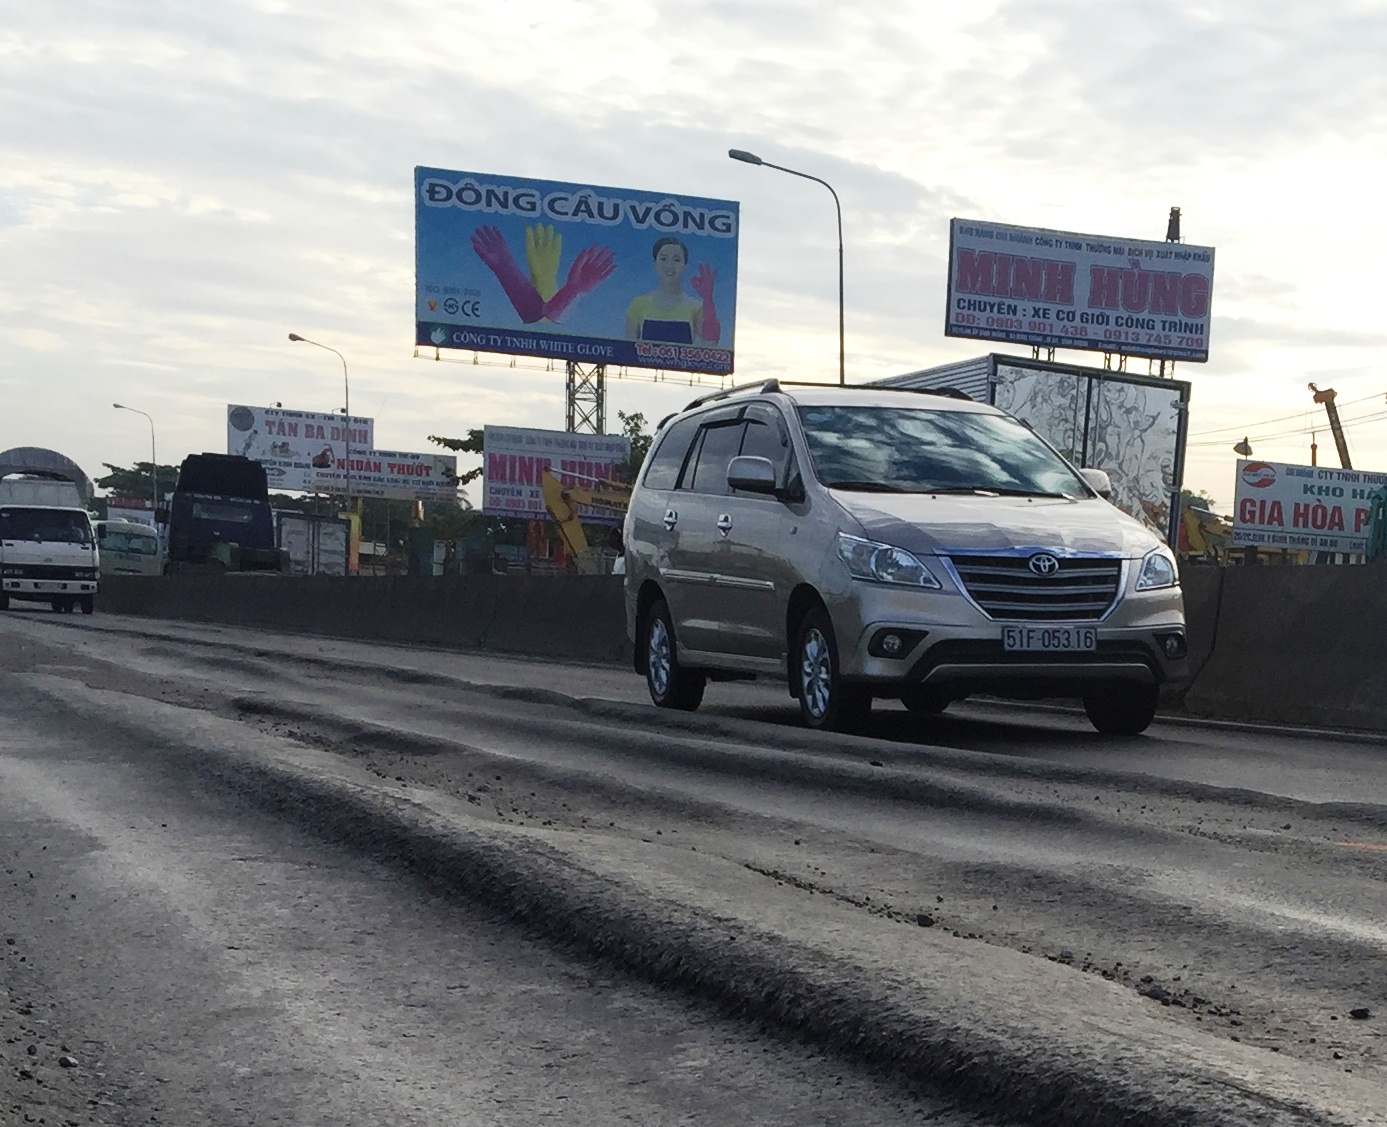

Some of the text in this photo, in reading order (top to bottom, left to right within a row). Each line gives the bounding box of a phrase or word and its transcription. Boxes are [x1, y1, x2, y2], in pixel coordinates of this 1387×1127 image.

[955, 247, 1210, 319] MINH HÙNG
[957, 298, 1017, 317] CHUYÊN
[1031, 306, 1051, 319] XE
[1056, 309, 1076, 322] CƠ
[1115, 315, 1155, 331] CÔNG
[1160, 319, 1204, 335] TRÌNH
[452, 330, 614, 357] CÔNG TY TNHH WHITE GLOVE
[305, 423, 325, 440] BA
[1303, 484, 1344, 497] KHO
[1318, 470, 1334, 480] CTY
[1336, 471, 1359, 483] TNHH
[1363, 473, 1387, 485] THƯƠ
[1240, 498, 1284, 527] GIA
[1293, 498, 1344, 531] HÒA
